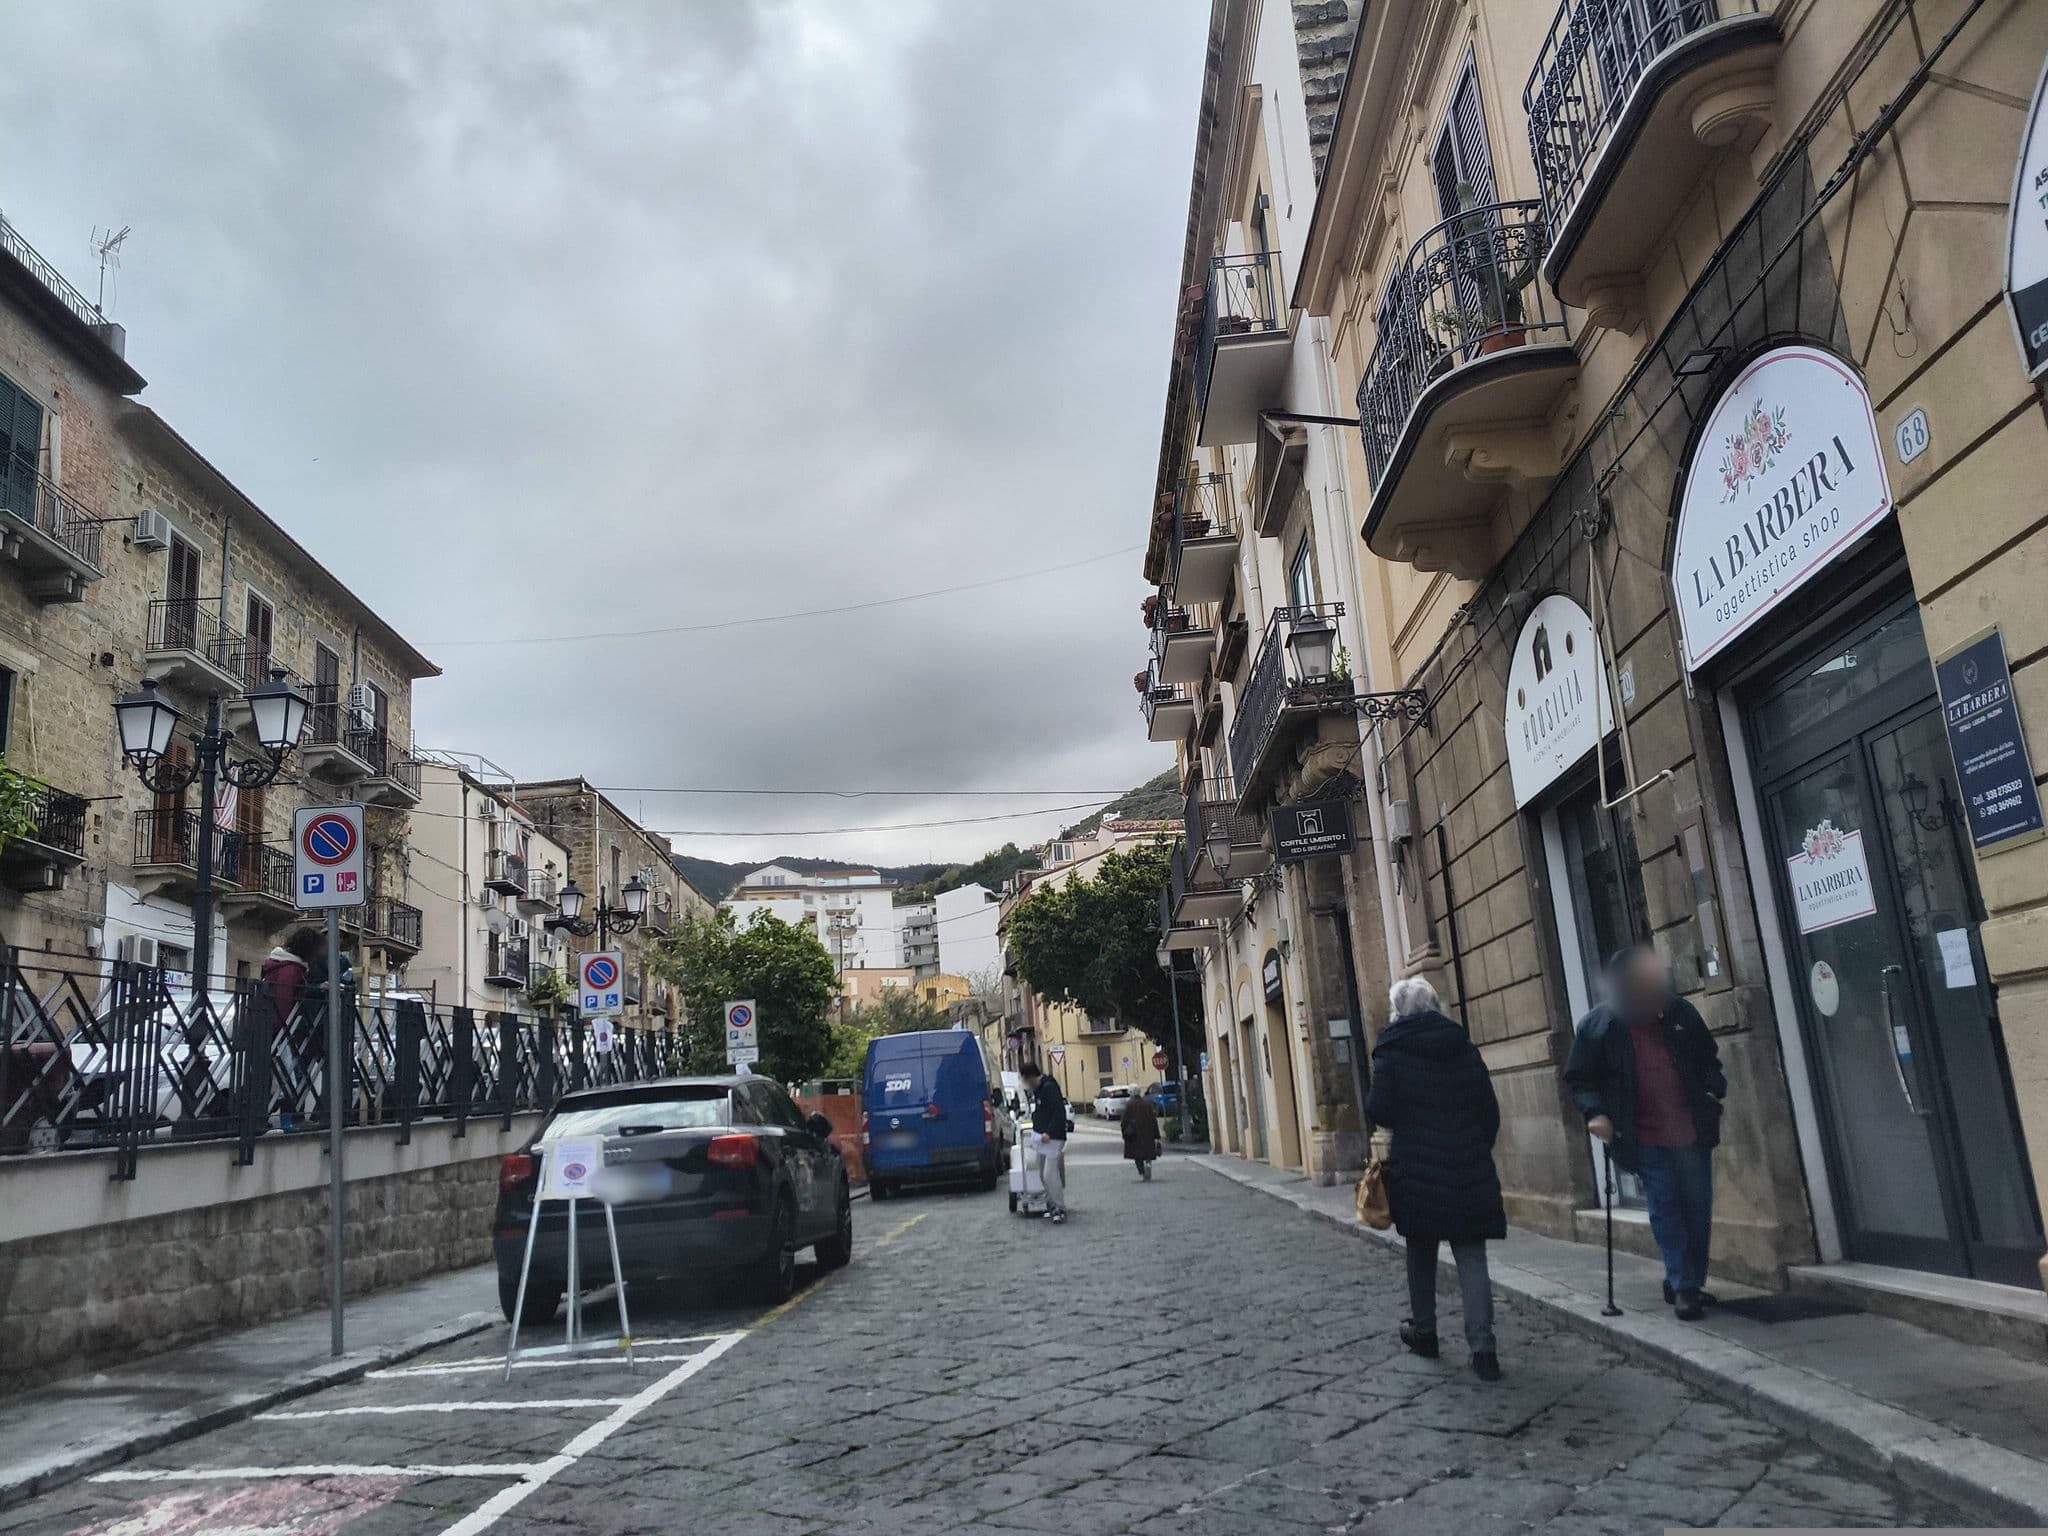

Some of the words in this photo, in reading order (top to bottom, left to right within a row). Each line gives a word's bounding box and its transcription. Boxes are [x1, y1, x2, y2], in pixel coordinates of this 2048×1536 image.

[1901, 416, 1925, 456] 68
[1691, 555, 1726, 609] LA
[1725, 435, 1856, 580] BARBERA
[1715, 543, 1798, 623] oggettistica
[1802, 506, 1841, 549] shop
[1522, 669, 1584, 753] HOUSILIA
[1963, 684, 2007, 716] BARBERA
[307, 876, 321, 892] P
[1798, 884, 1813, 902] LA
[1812, 866, 1863, 897] BARBERA
[587, 996, 597, 1008] P
[1152, 1054, 1168, 1066] STOP
